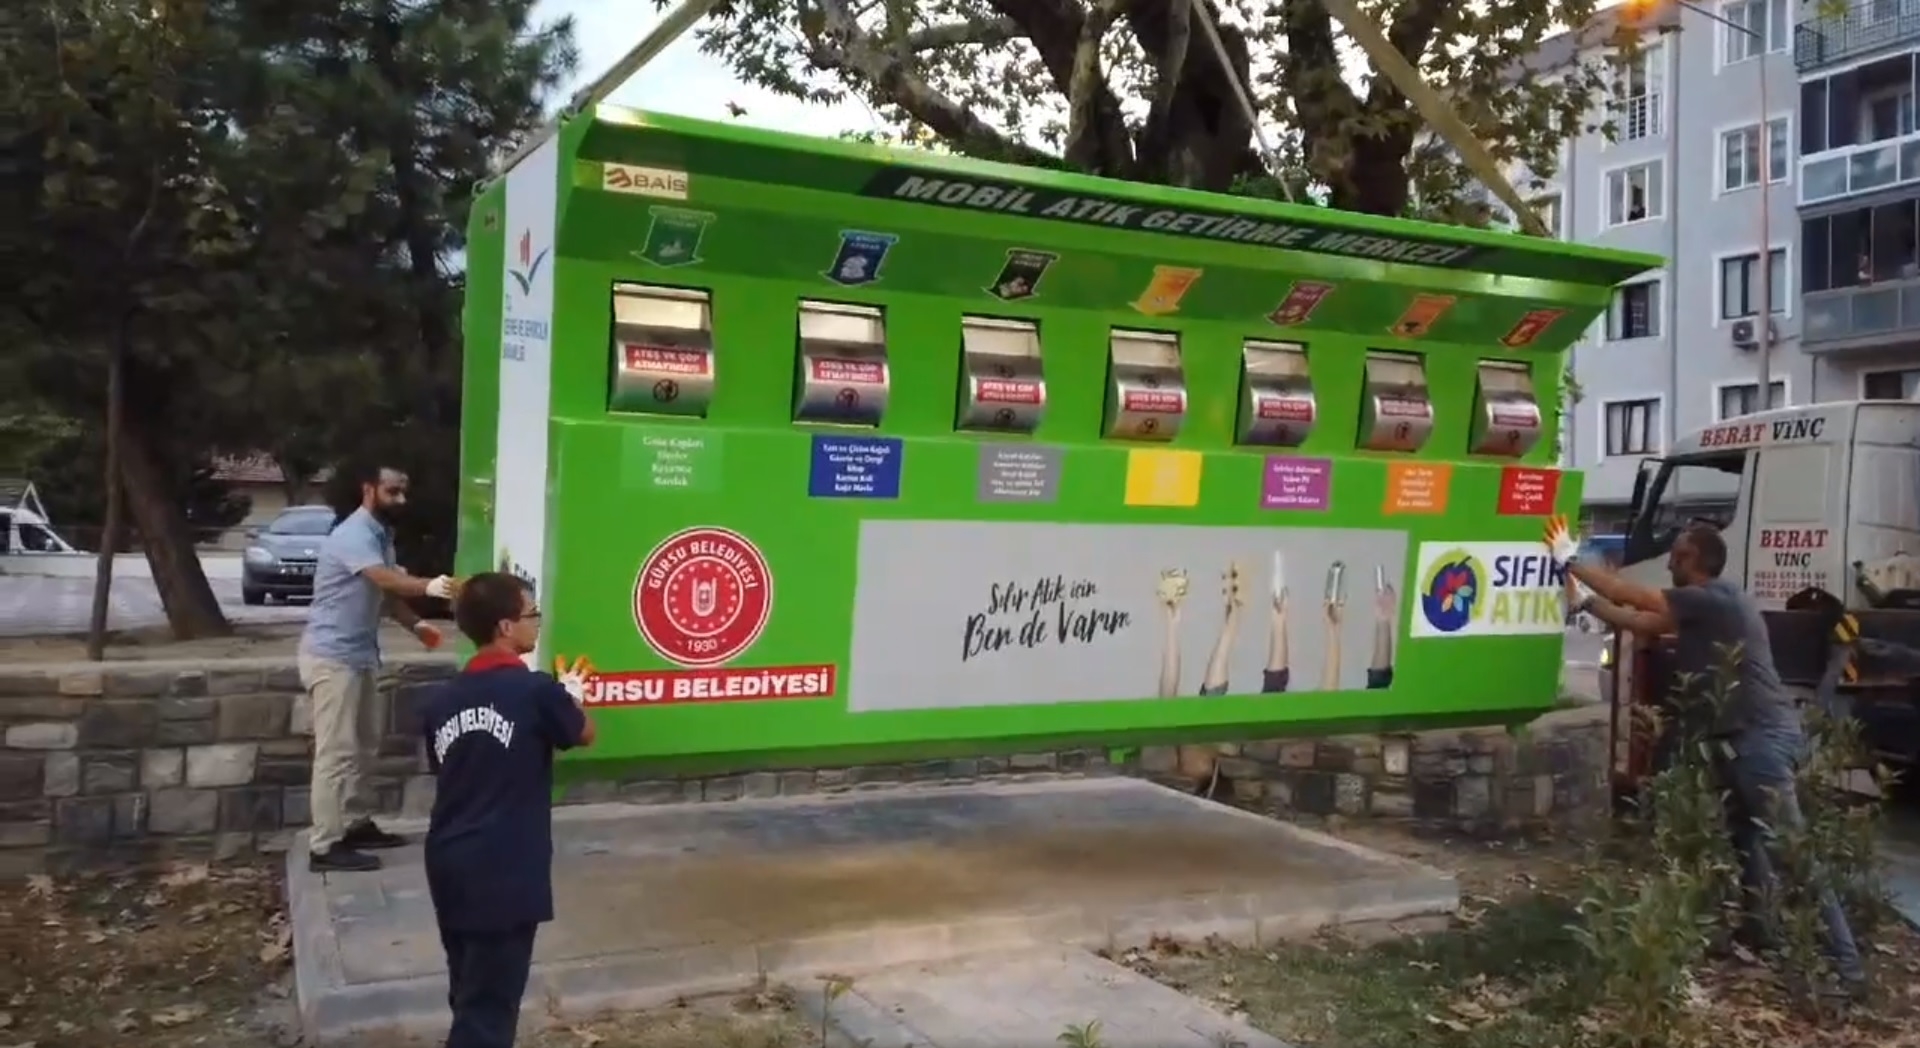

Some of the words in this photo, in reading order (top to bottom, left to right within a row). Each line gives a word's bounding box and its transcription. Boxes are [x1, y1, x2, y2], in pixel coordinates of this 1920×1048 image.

[634, 174, 687, 192] BAİS
[894, 176, 1036, 213] MOBİL
[1041, 197, 1142, 226] ATIK
[1141, 210, 1315, 246] GETİRME
[1311, 231, 1474, 264] MERKEZİ
[1699, 423, 1766, 447] BERAT
[1773, 417, 1826, 440] VİNÇ
[1760, 529, 1829, 549] BERAT
[649, 547, 688, 589] GÜRSU
[1774, 551, 1811, 569] VİNÇ
[1070, 578, 1098, 600] için
[1491, 590, 1563, 625] ATIK
[687, 638, 718, 653] 1930
[963, 612, 1013, 662] Ben
[1019, 610, 1048, 648] de
[1058, 601, 1132, 644] Varım
[584, 676, 665, 703] ÜRSU
[673, 667, 829, 699] BELEDİYESİ
